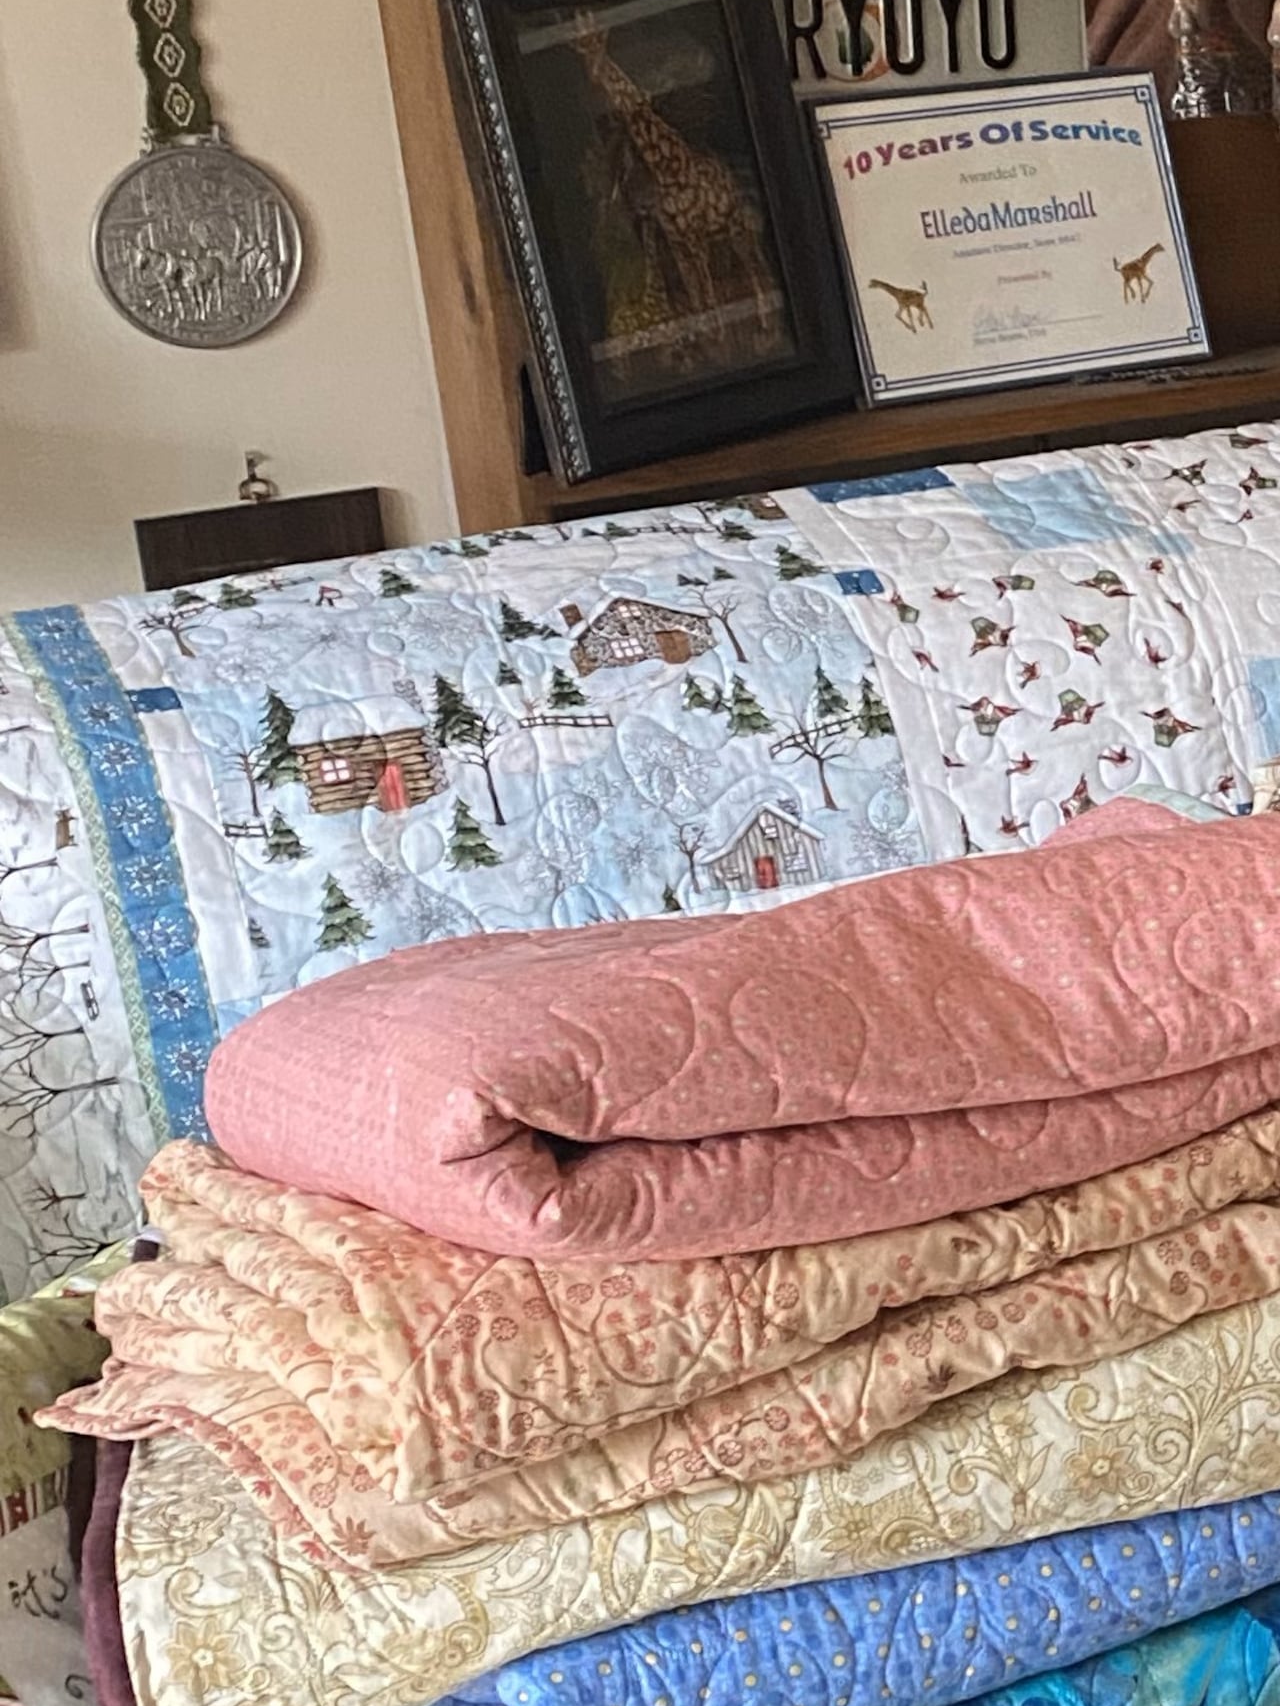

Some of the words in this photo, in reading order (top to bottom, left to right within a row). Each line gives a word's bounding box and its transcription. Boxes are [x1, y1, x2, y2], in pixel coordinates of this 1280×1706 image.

[842, 150, 873, 181] 10
[874, 130, 975, 167] Years
[979, 120, 1025, 146] Of
[1030, 118, 1144, 147] Service
[958, 166, 1018, 185] Awarded
[1020, 162, 1039, 179] To
